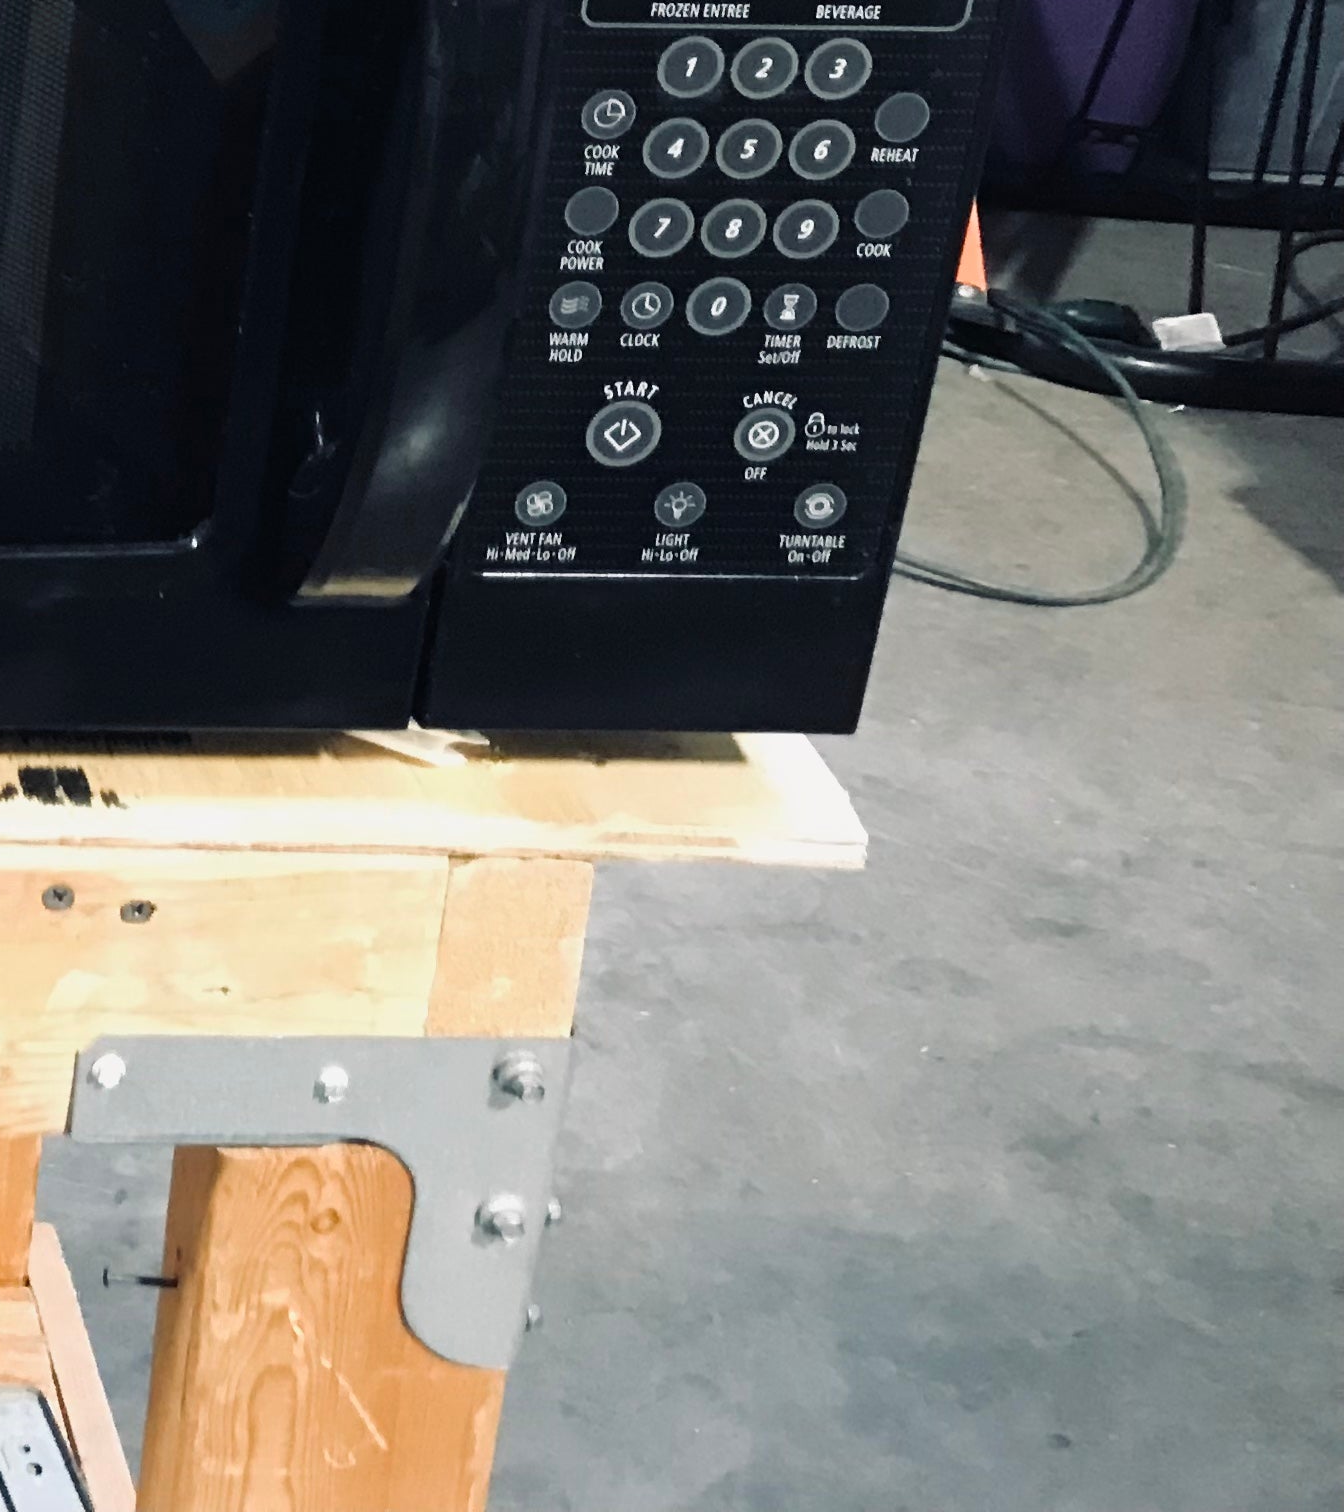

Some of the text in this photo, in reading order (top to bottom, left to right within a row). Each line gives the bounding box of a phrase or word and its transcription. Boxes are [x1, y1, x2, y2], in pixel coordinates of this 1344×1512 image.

[650, 2, 751, 19] FROZEN ENTREE
[815, 4, 882, 20] BEVERAGE
[685, 56, 698, 78] 1
[754, 57, 773, 79] 2
[828, 57, 848, 79] 3
[584, 144, 621, 160] COOK
[666, 137, 685, 159] 4
[739, 138, 759, 160] 5
[813, 139, 832, 160] 6
[870, 147, 920, 163] REHEAT
[584, 161, 615, 176] TIME
[653, 217, 672, 239] 7
[724, 218, 743, 239] 8
[797, 218, 815, 240] 9
[567, 239, 604, 255] COOK
[856, 242, 892, 258] COOK
[559, 255, 604, 271] POWER
[710, 296, 727, 317] 0
[549, 332, 589, 347] WARM
[619, 332, 661, 347] CLOCK
[764, 334, 802, 349] TIMER
[826, 335, 882, 350] DEFROST
[548, 348, 583, 363] HOLD
[603, 380, 660, 400] START
[742, 390, 798, 411] CANCEL
[744, 466, 768, 481] OFF
[505, 532, 563, 546] VENT FAN
[655, 532, 691, 547] LIGHT
[779, 534, 846, 549] TURNTABLE
